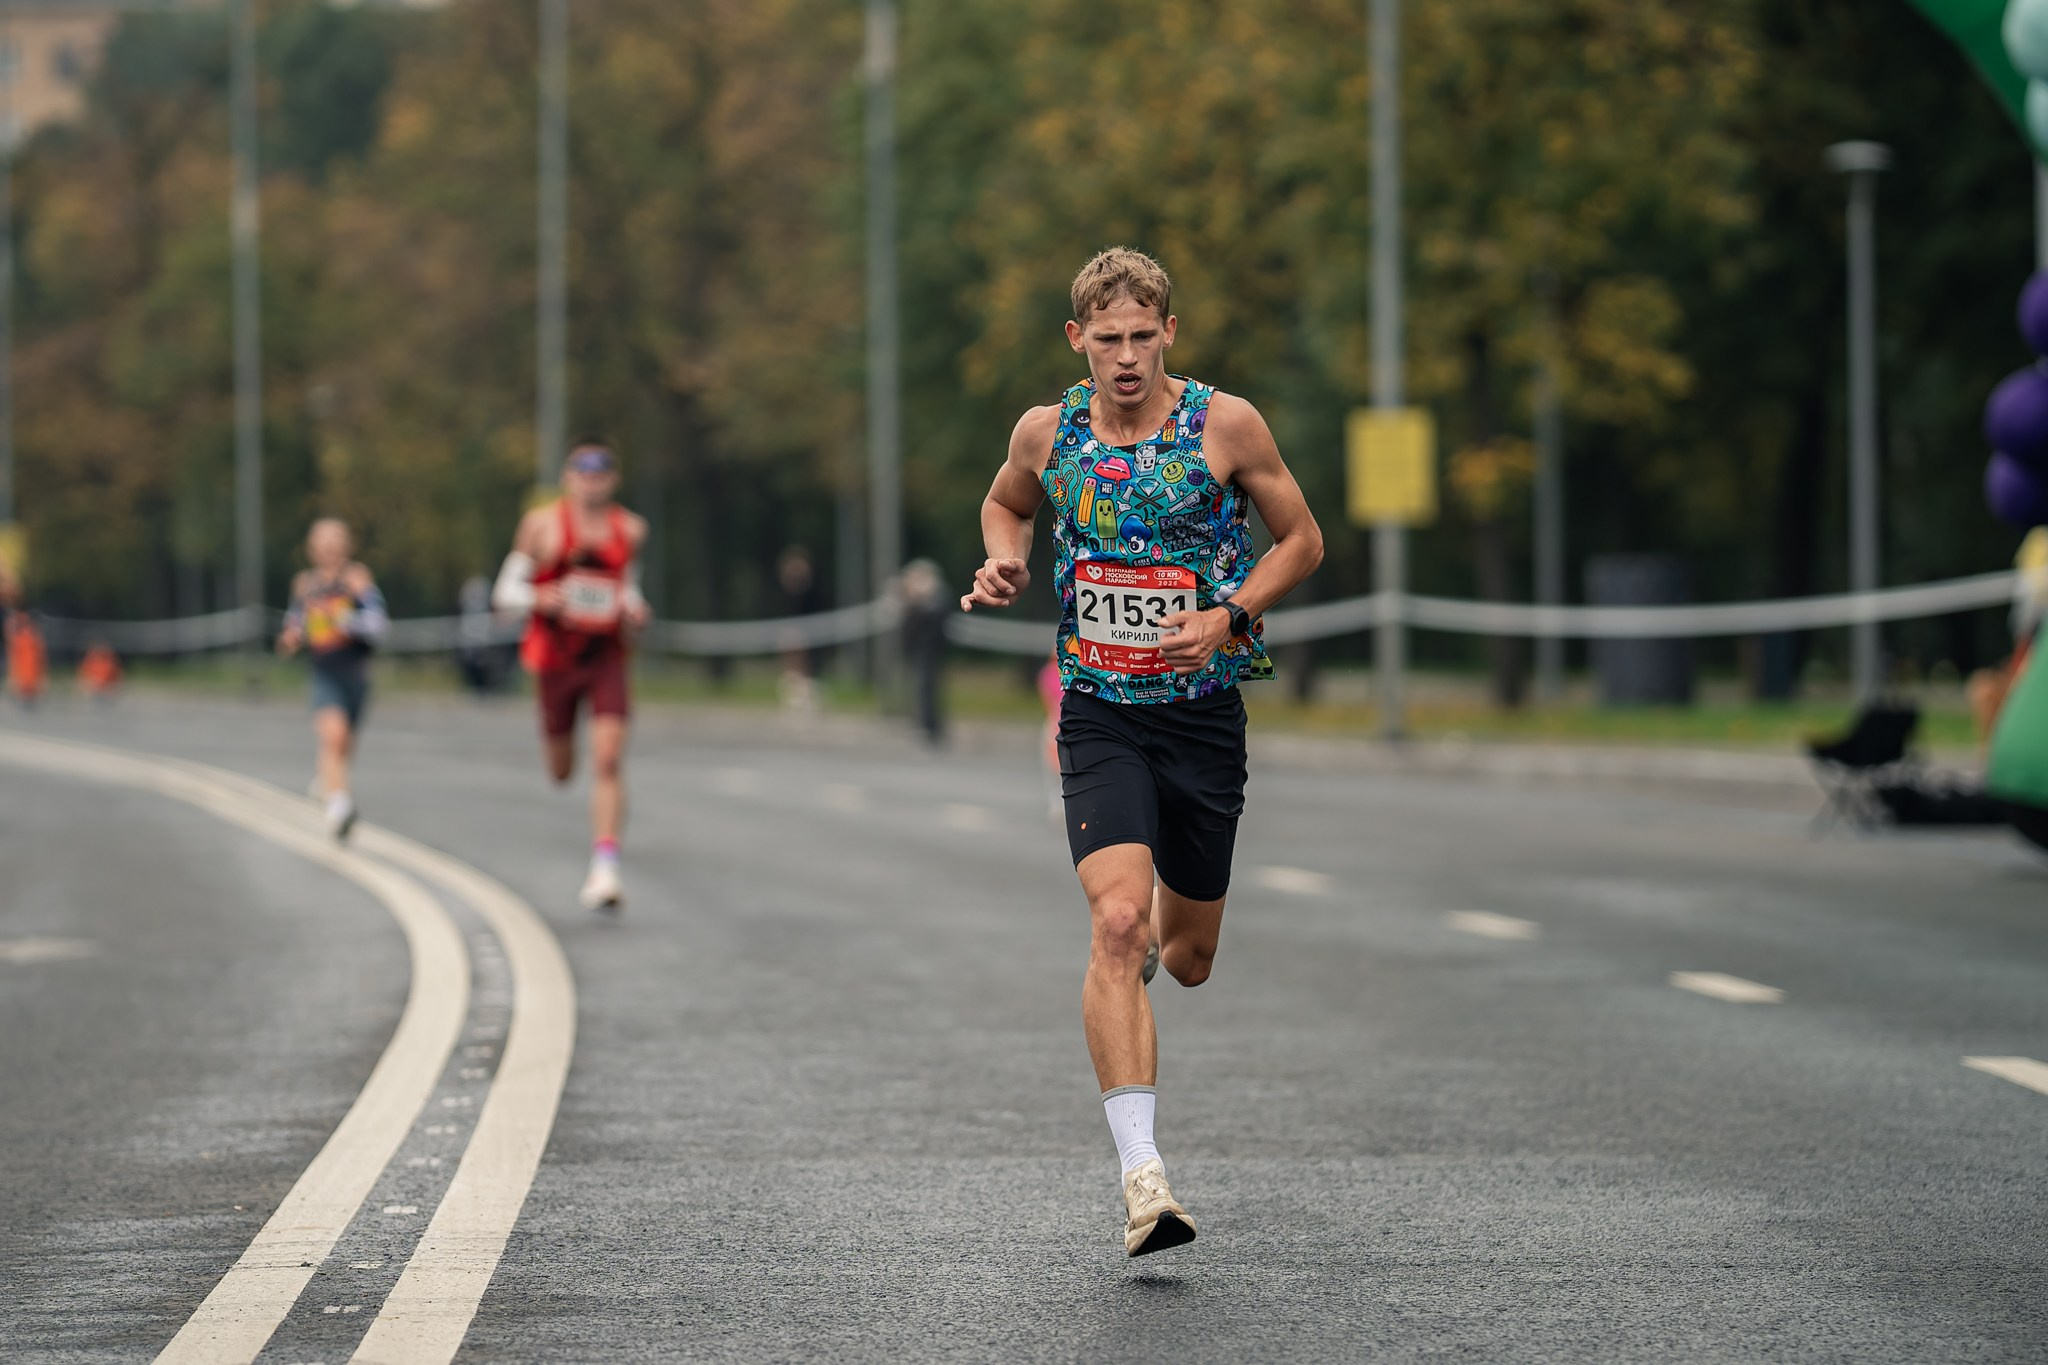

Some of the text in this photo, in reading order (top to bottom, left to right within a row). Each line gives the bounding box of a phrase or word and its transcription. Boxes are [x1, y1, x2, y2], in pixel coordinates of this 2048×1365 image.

[1179, 446, 1190, 454] IS
[1105, 573, 1148, 581] МОСКОВСКИЙ
[1111, 629, 1158, 642] КИРИЛЛ
[1128, 678, 1164, 690] DANG
